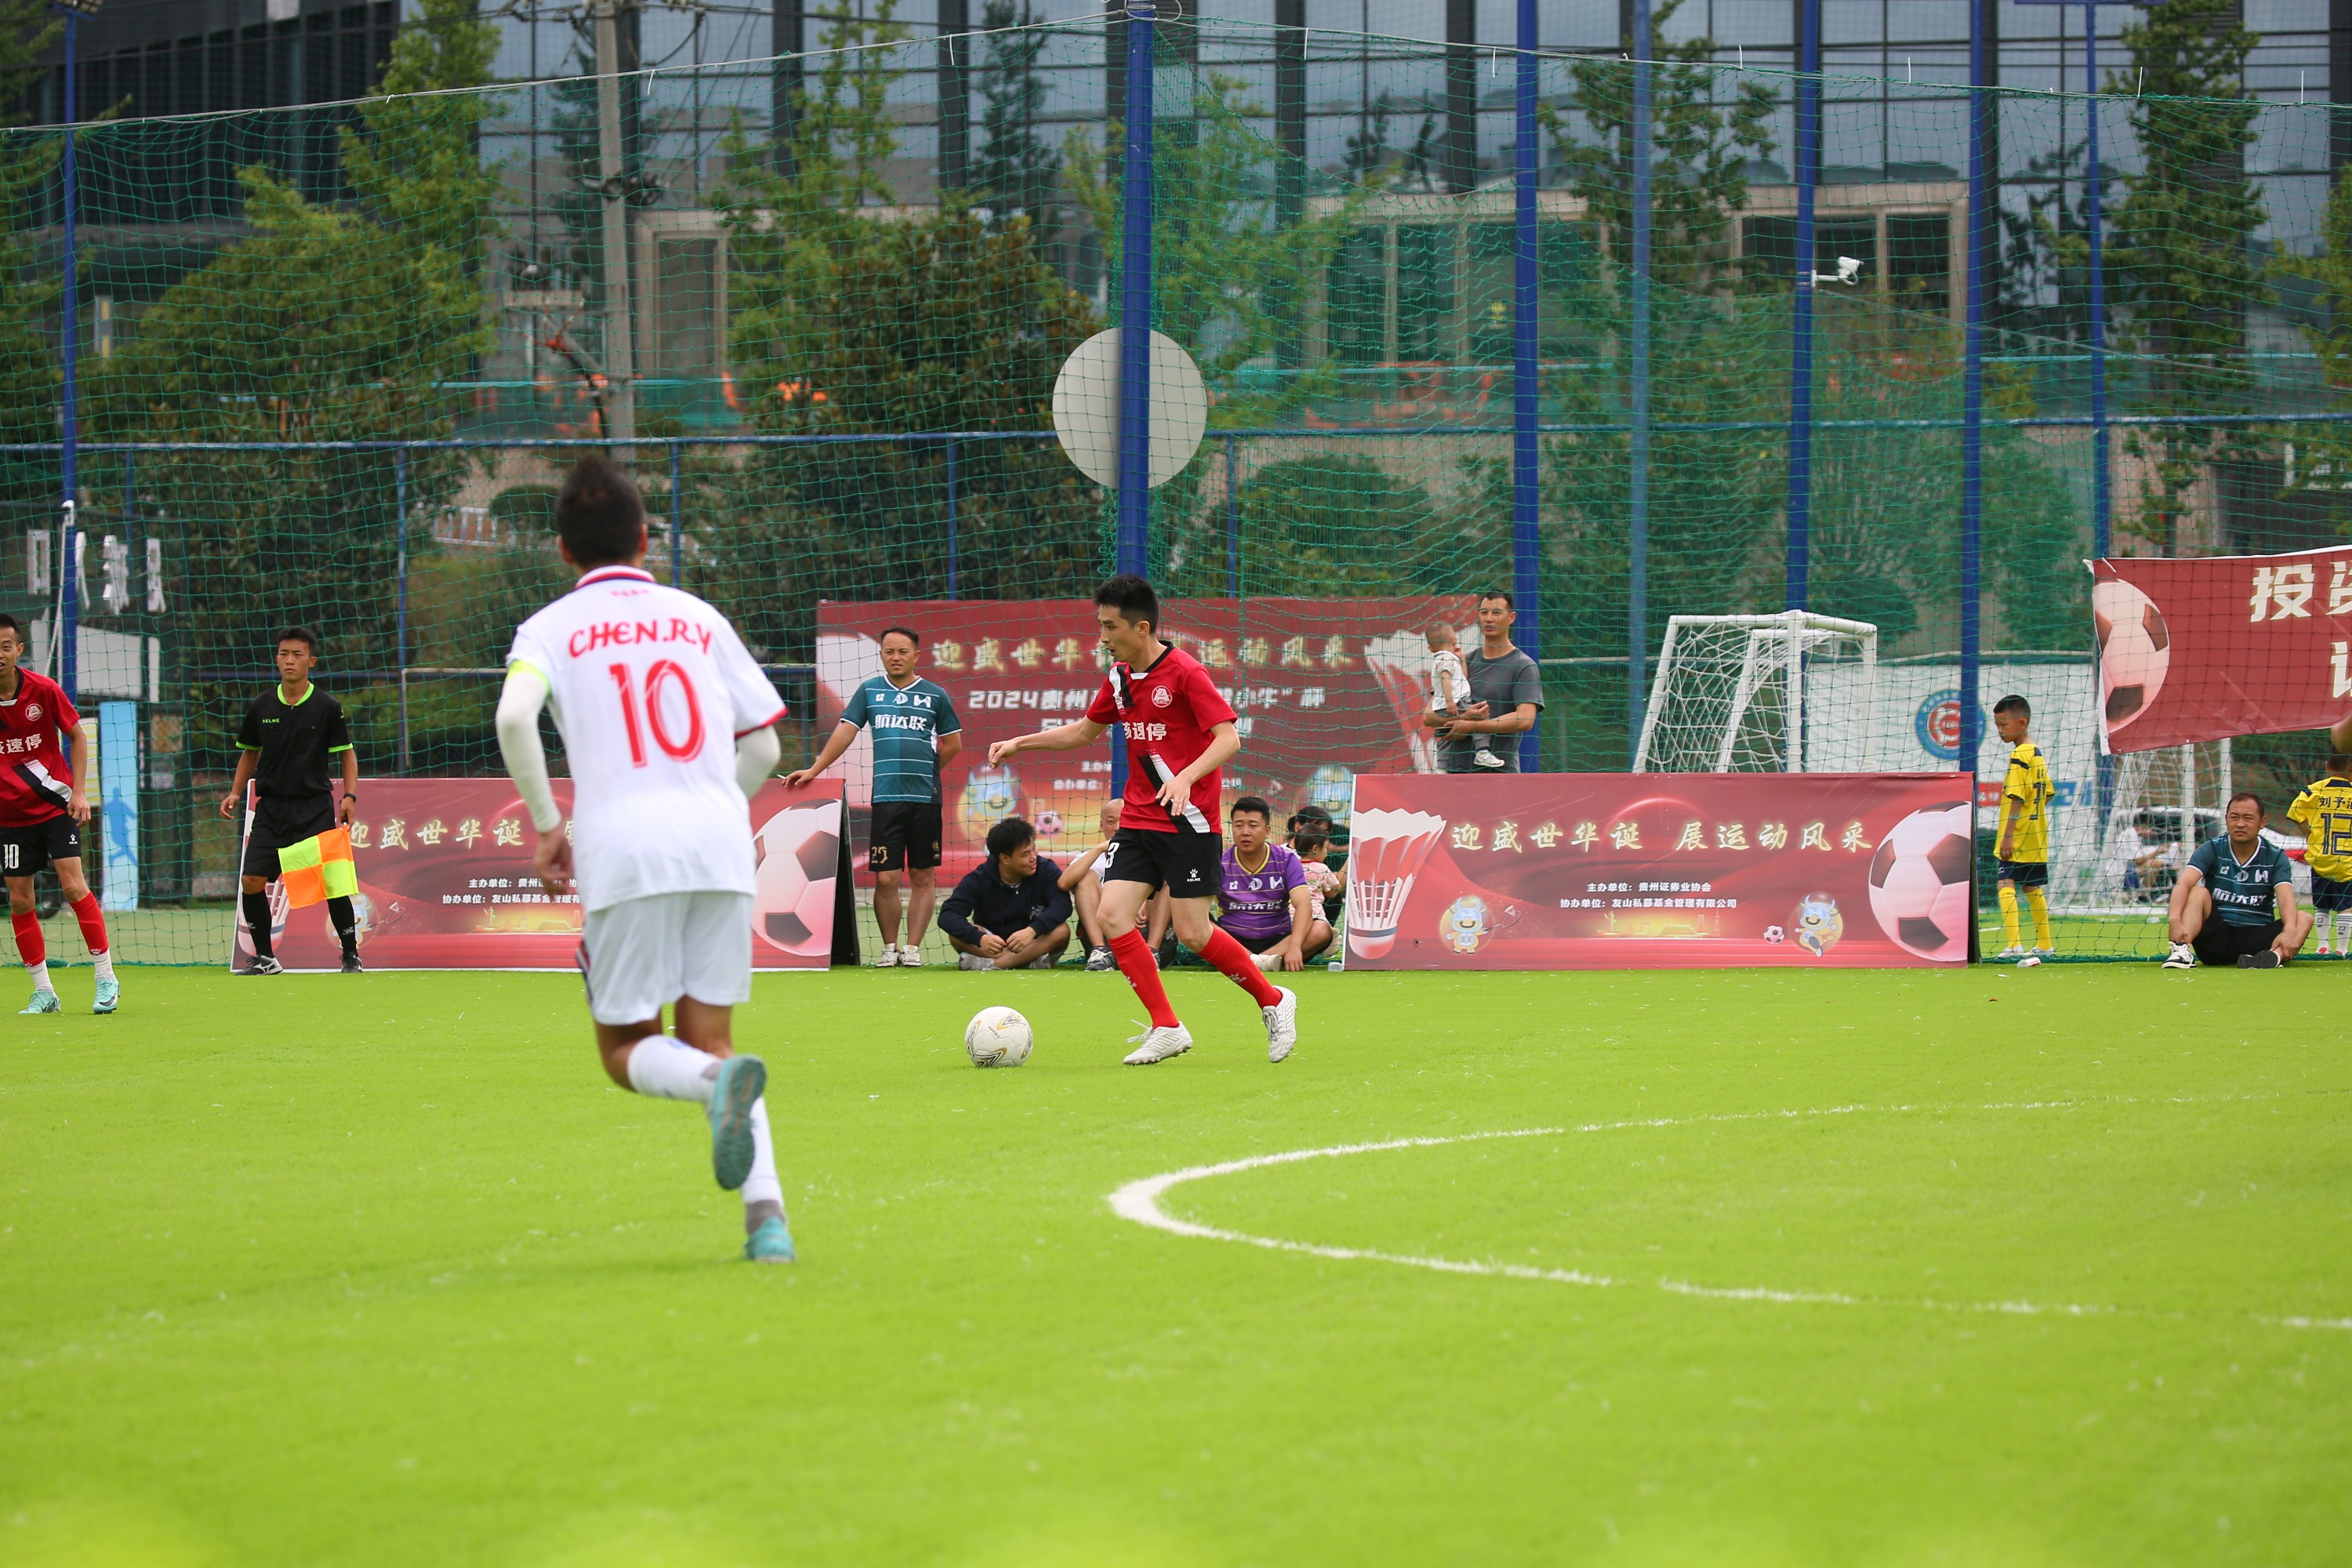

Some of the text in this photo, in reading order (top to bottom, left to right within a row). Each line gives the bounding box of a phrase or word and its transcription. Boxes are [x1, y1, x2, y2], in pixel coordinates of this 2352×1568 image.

[568, 618, 712, 657] CHEN.RY
[1173, 633, 1352, 669] 运动风采
[608, 658, 706, 769] 10
[969, 688, 1100, 710] 2024贵州
[350, 818, 524, 851] 迎盛世华诞
[1452, 820, 1873, 854] 迎盛世华诞 展运动风采
[2321, 813, 2352, 855] 12
[468, 878, 577, 888] 主办单位：贵州协
[1560, 898, 1737, 909] 协办单位：友山私募基金管理有限公司
